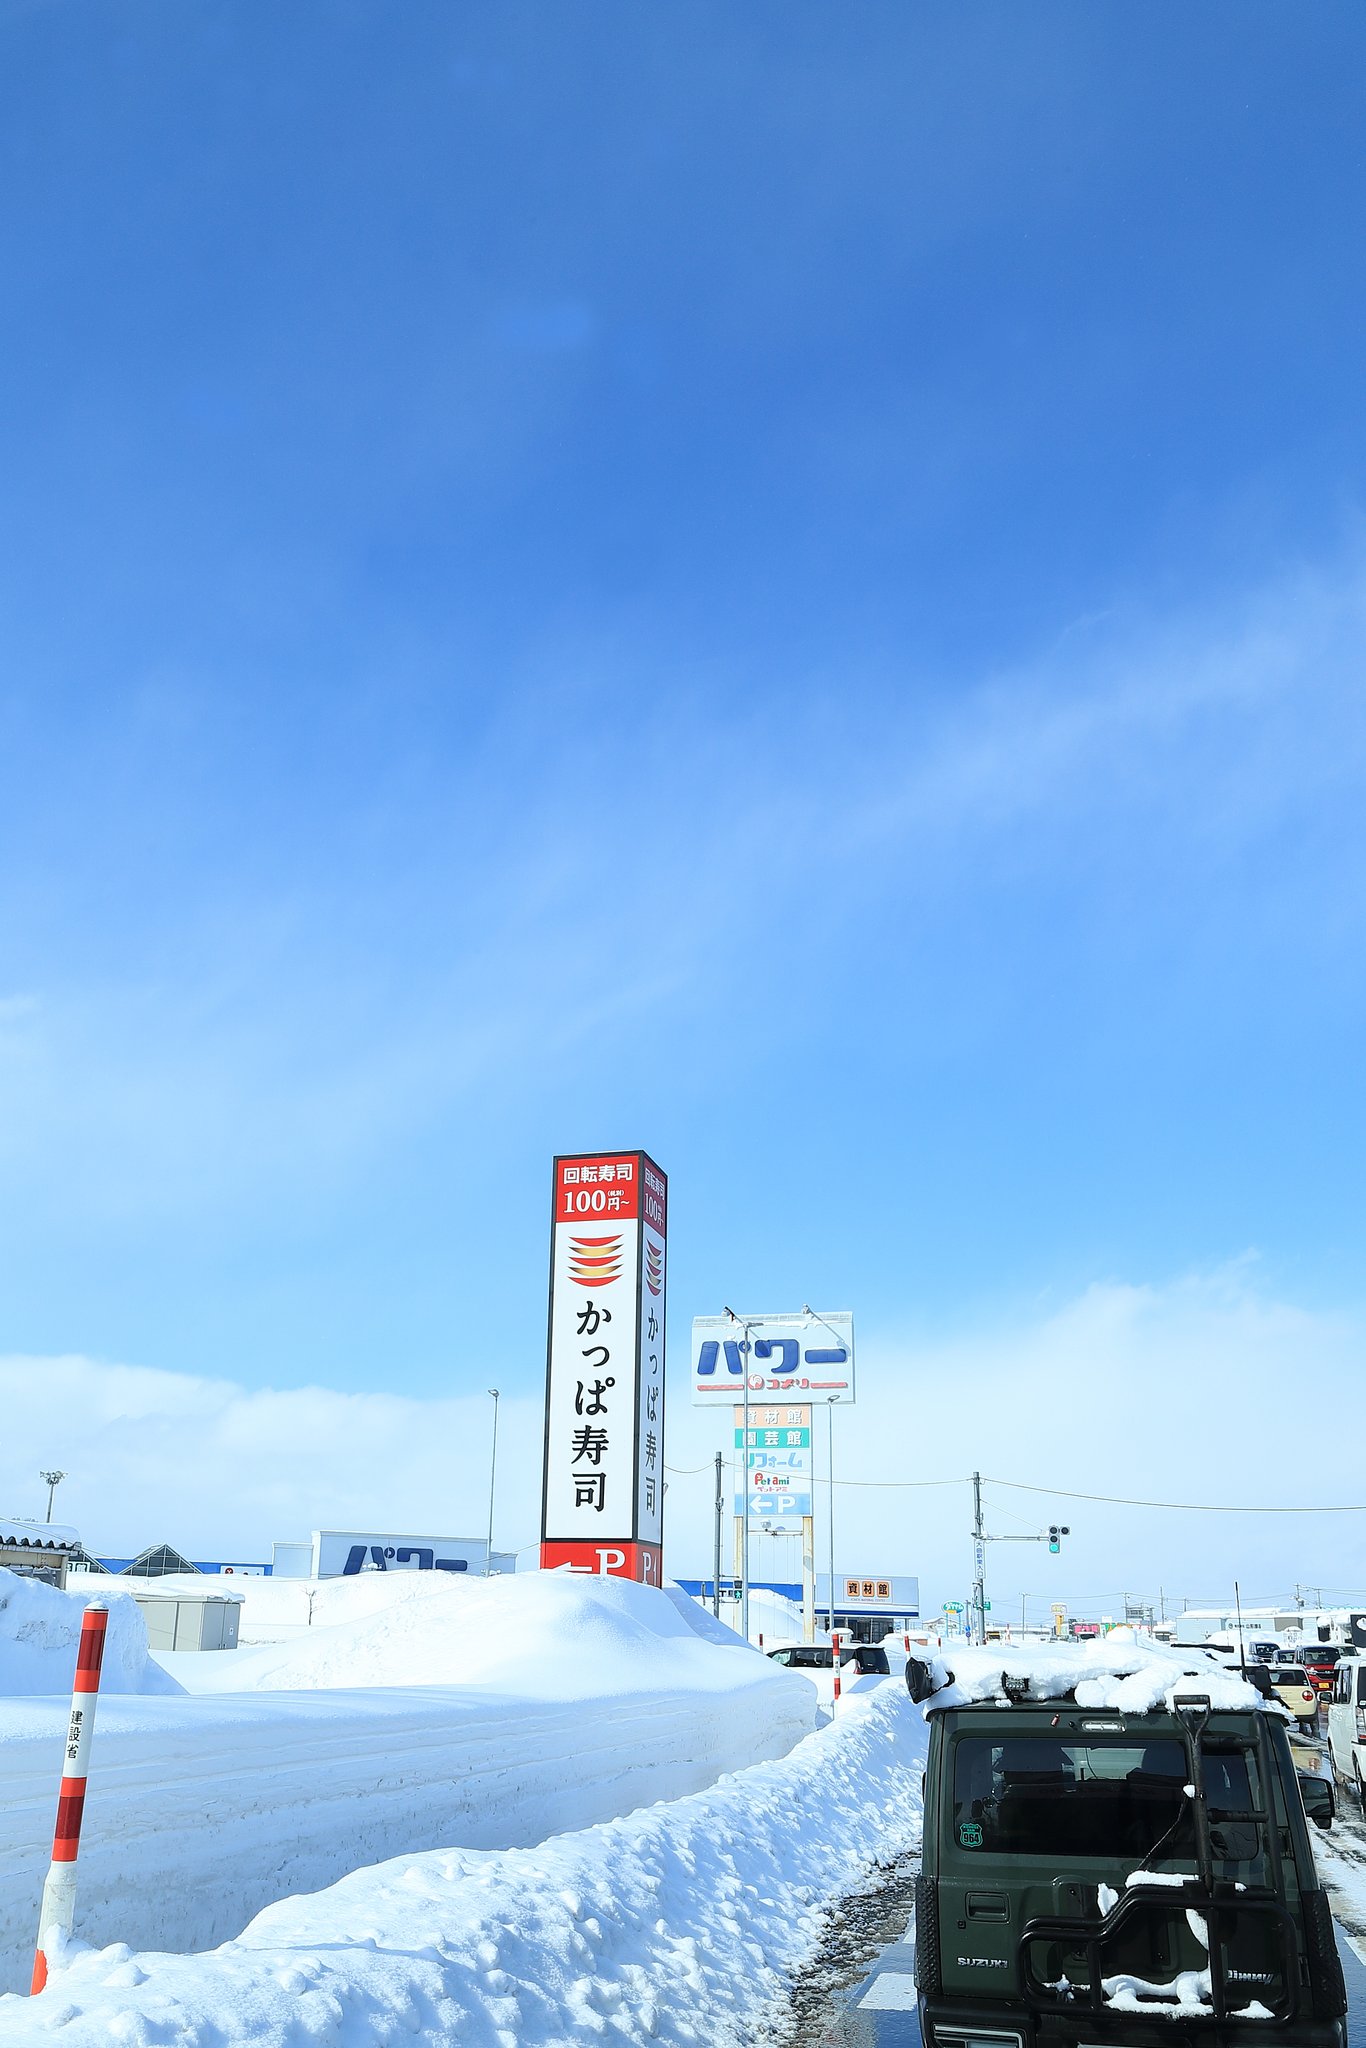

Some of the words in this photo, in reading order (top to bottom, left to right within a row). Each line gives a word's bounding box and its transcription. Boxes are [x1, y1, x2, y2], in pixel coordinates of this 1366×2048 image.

[563, 1163, 633, 1184] 回転寿司
[696, 1338, 847, 1375] パワー
[766, 1378, 810, 1390] コメリ
[570, 1300, 616, 1513] かっぱ寿司
[742, 1452, 803, 1469] リフォーム
[777, 1495, 796, 1514] P
[595, 1548, 626, 1576] P
[848, 1582, 888, 1595] 資材館
[66, 1710, 83, 1760] 建設省
[963, 1833, 980, 1843] 964
[957, 1957, 1008, 1969] SUZUKI
